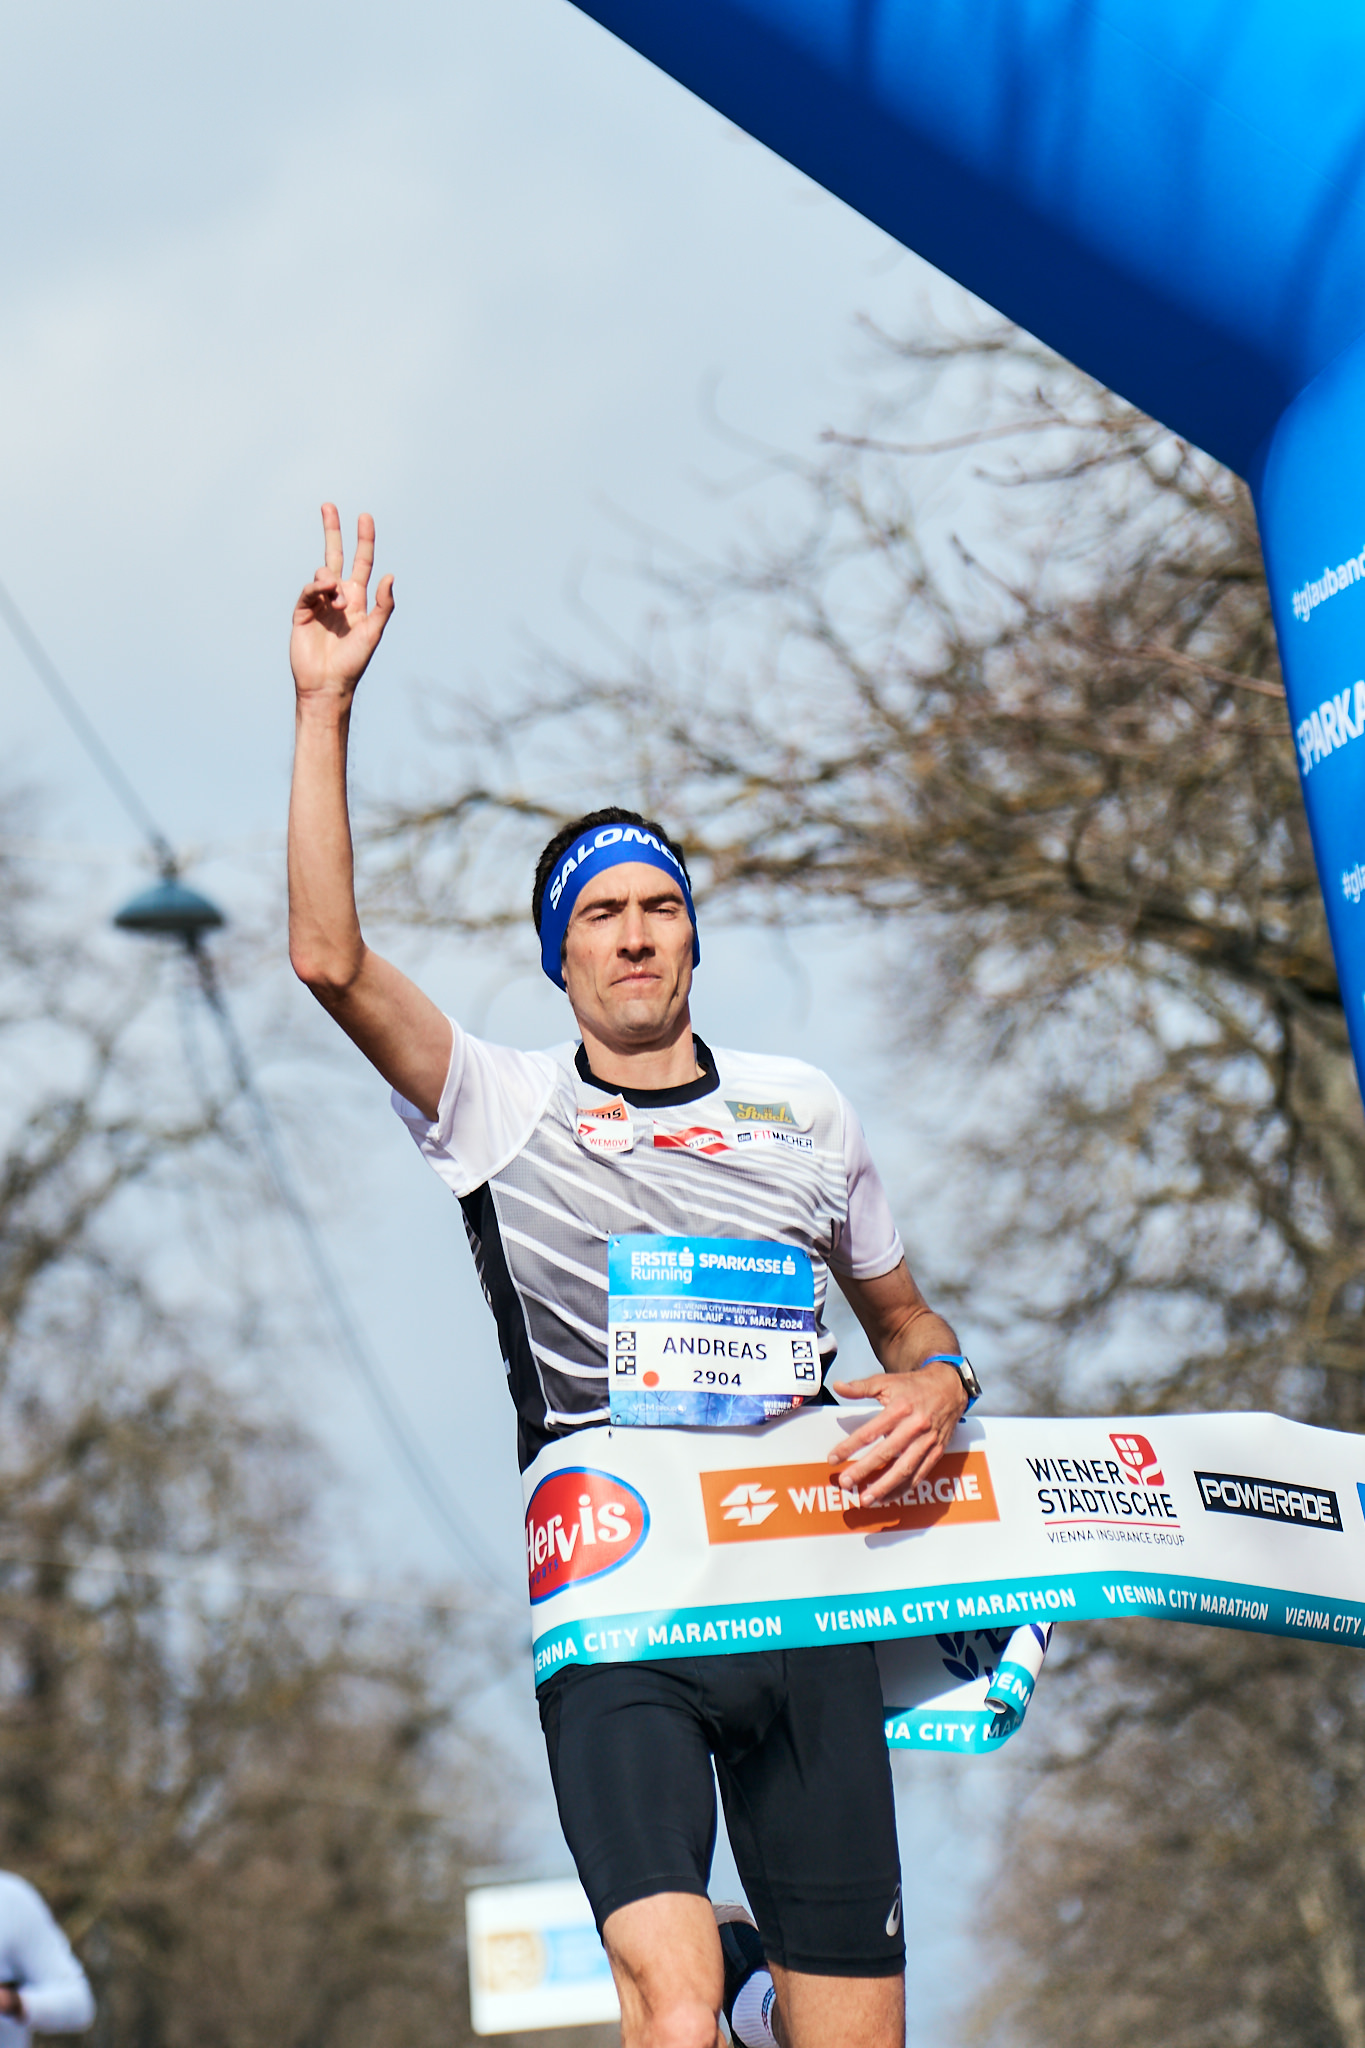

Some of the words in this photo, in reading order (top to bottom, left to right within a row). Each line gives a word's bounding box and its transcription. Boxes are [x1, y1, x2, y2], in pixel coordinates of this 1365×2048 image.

[550, 828, 690, 910] SALOMO
[754, 1130, 813, 1149] FITMACHER
[631, 1251, 677, 1267] ERSTE
[699, 1252, 781, 1275] SPARKASSE
[631, 1266, 692, 1284] Running
[635, 1309, 658, 1320] VCM
[660, 1309, 724, 1323] WINTERLAUF
[734, 1315, 748, 1326] 10.
[750, 1315, 778, 1328] MÄRZ
[780, 1319, 803, 1330] 2024
[685, 1303, 708, 1312] VIENNA
[709, 1305, 722, 1313] CITY
[723, 1306, 757, 1316] MARATHON
[663, 1337, 767, 1360] ANDREAS
[693, 1370, 742, 1387] 2904
[1026, 1458, 1124, 1484] WIENER
[788, 1484, 861, 1515] WIEN
[867, 1475, 982, 1509] ERGIE
[1038, 1488, 1178, 1518] STÄDTISCHE
[1200, 1478, 1335, 1523] POWERADE
[525, 1494, 632, 1573] Hervis
[1047, 1530, 1094, 1544] VIENNA
[1096, 1529, 1152, 1544] INSURANCE
[1154, 1533, 1185, 1546] GROUP
[815, 1606, 898, 1632] VIENNA
[902, 1599, 950, 1624] CITY
[956, 1588, 1077, 1618] MARATHON
[1102, 1584, 1167, 1606] VIENNA
[1169, 1589, 1198, 1611] CITY
[1201, 1593, 1269, 1621] MARATHON
[584, 1627, 639, 1651] CITY
[648, 1615, 782, 1646] MARATHON
[1285, 1607, 1330, 1631] VIENNA
[1333, 1614, 1362, 1635] CITY
[919, 1722, 976, 1742] CITY
